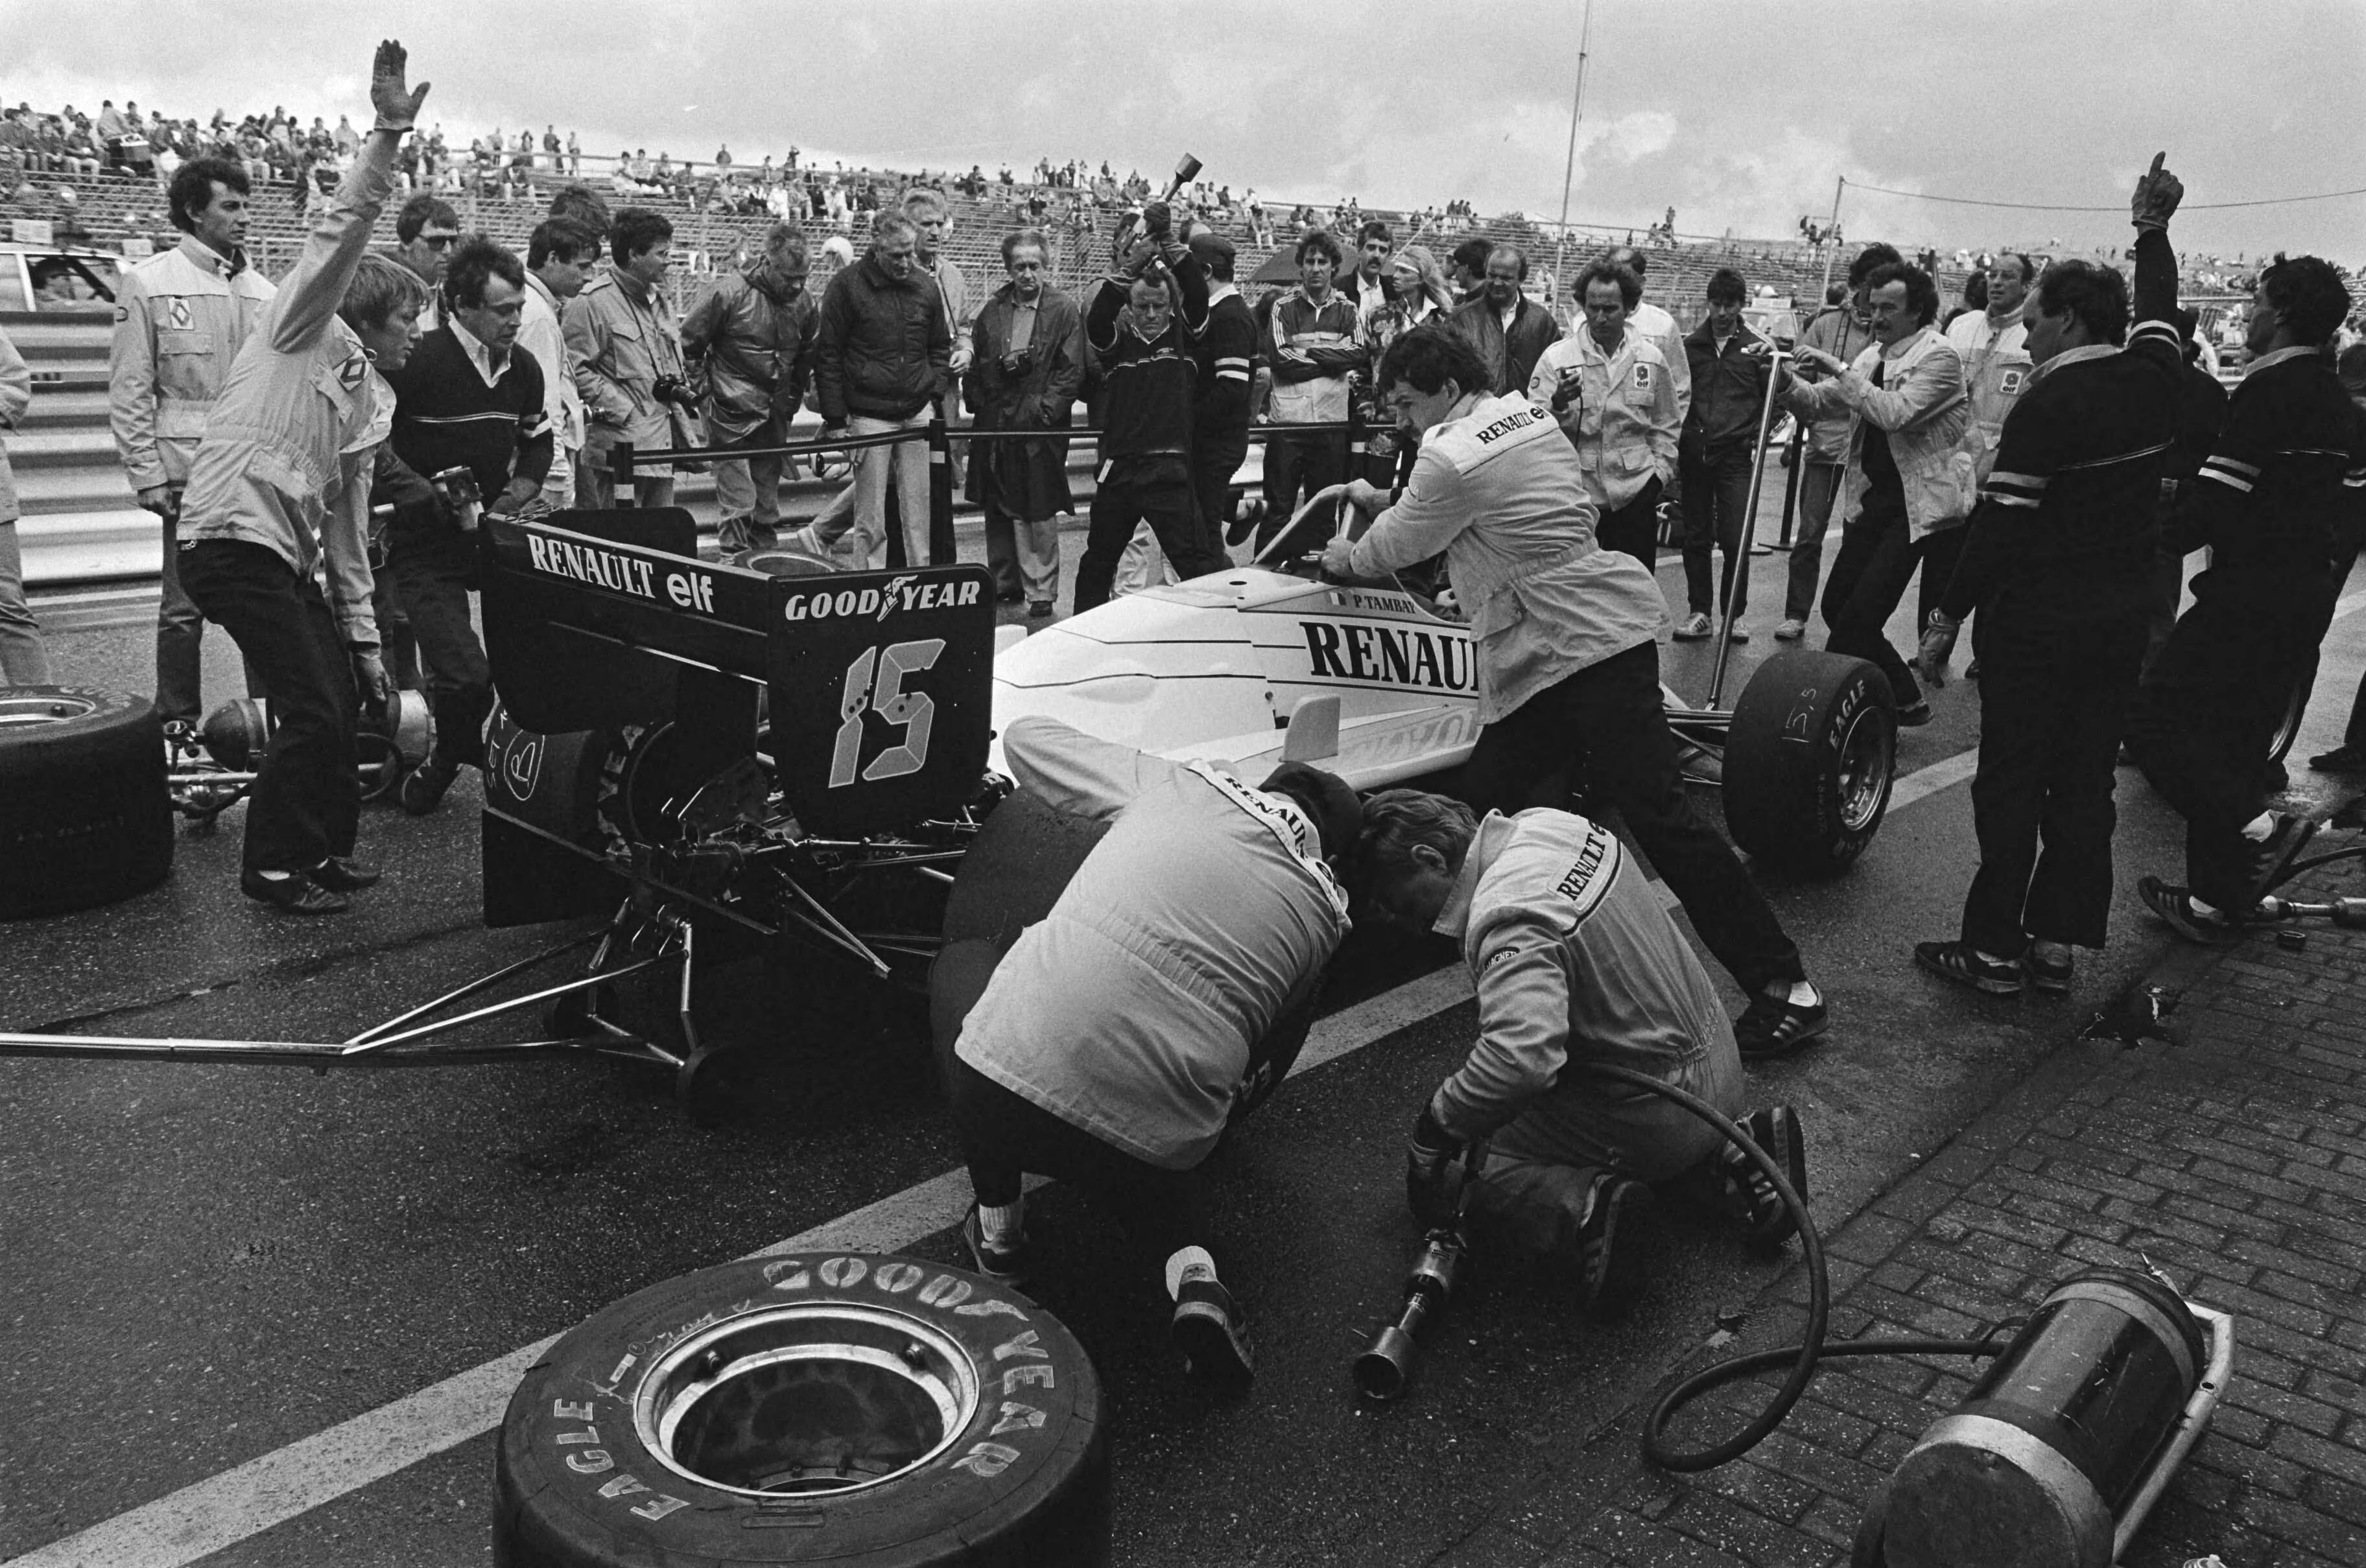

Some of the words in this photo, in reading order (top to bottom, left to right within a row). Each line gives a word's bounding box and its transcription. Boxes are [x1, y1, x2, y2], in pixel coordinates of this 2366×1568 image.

[1475, 412, 1535, 445] RENAULT
[526, 534, 656, 599] RENAULT
[667, 572, 714, 613] elf
[1299, 622, 1479, 692] RENAU
[828, 638, 946, 788] 15
[1557, 832, 1607, 902] RENAULT
[553, 1398, 692, 1521] EAGLE
